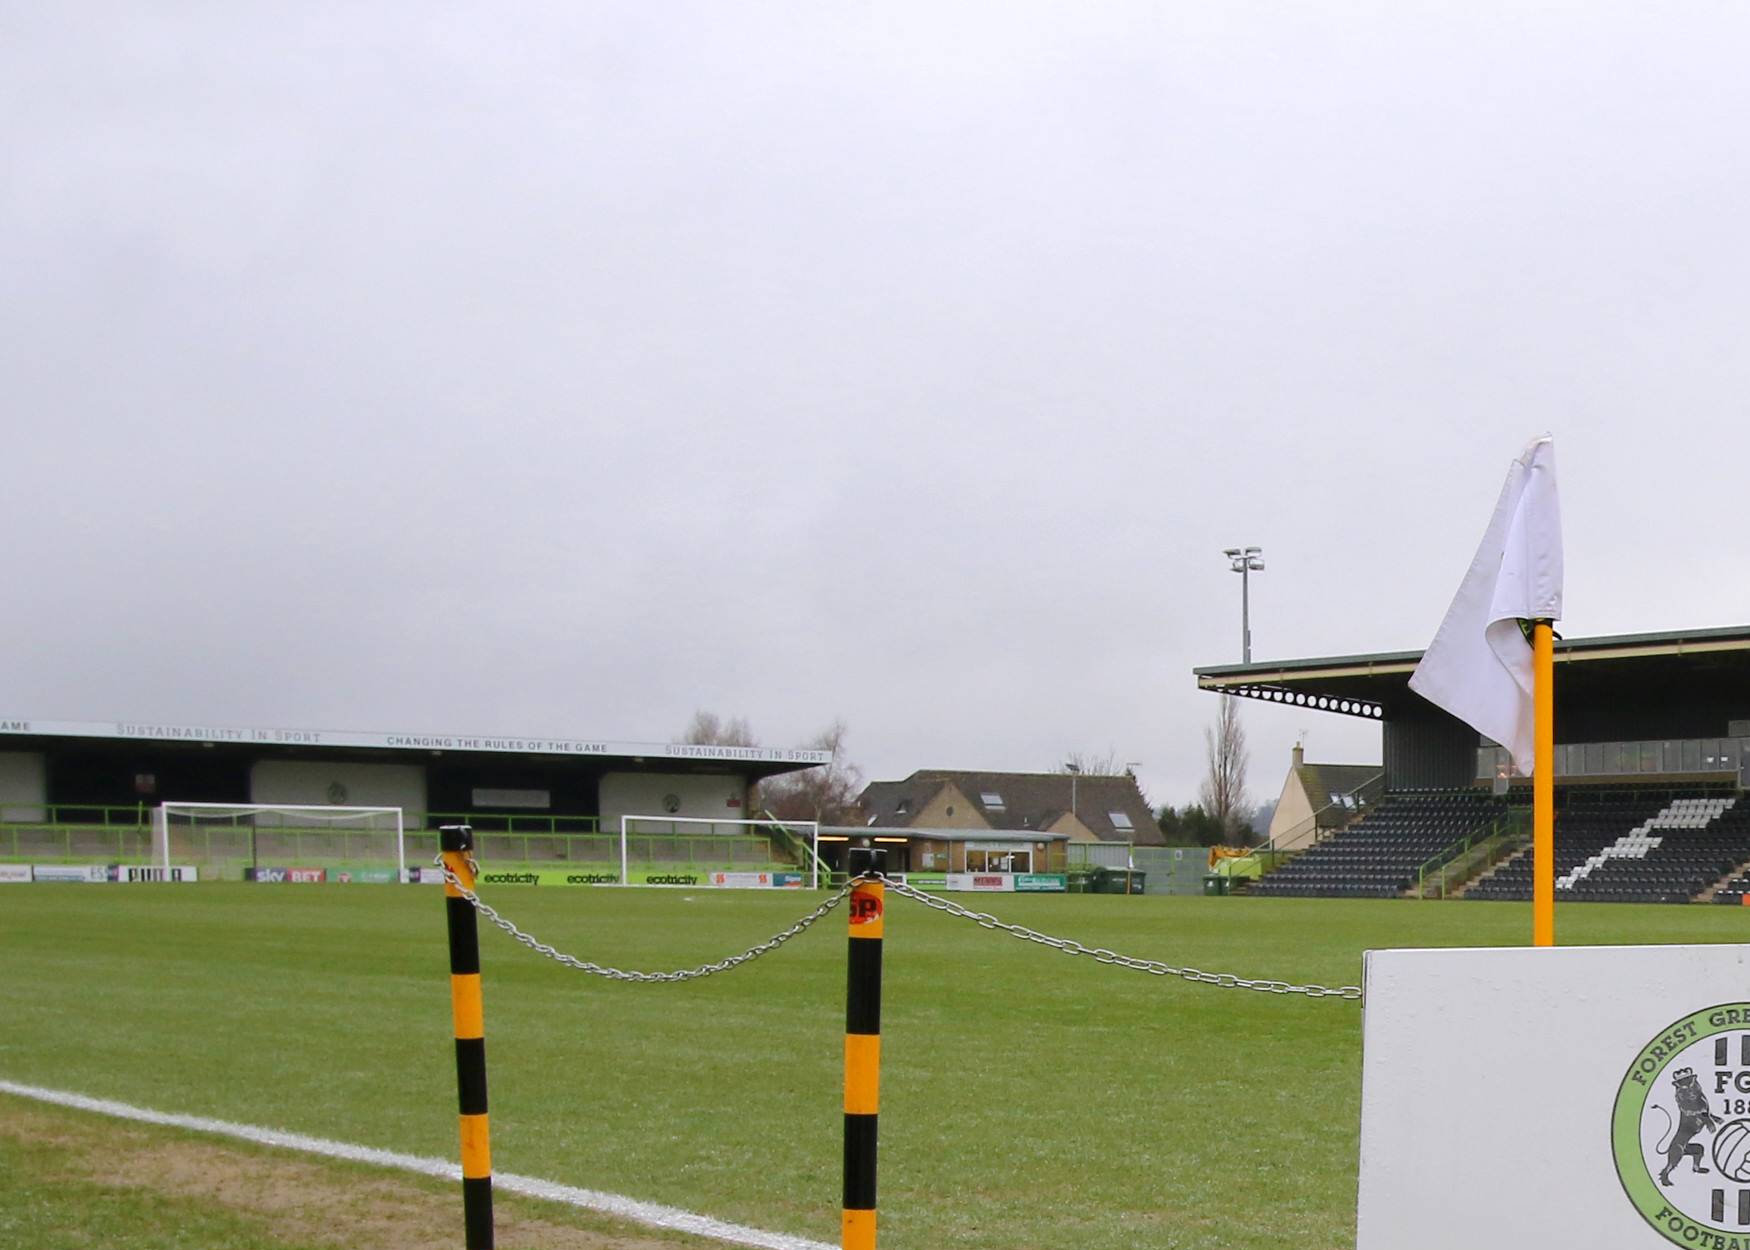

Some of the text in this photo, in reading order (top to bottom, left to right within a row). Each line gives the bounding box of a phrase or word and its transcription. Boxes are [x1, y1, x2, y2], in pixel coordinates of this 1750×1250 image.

[275, 729, 321, 743] SPORT
[387, 736, 608, 753] CHANGING THE RULES OF THE GAME
[665, 744, 763, 760] SUSTAINABILITY
[788, 750, 824, 761] SPORT
[256, 868, 321, 883] sky BET
[484, 873, 698, 886] ecotricity ecotricity ecotricity
[1631, 1020, 1698, 1086] FOREST
